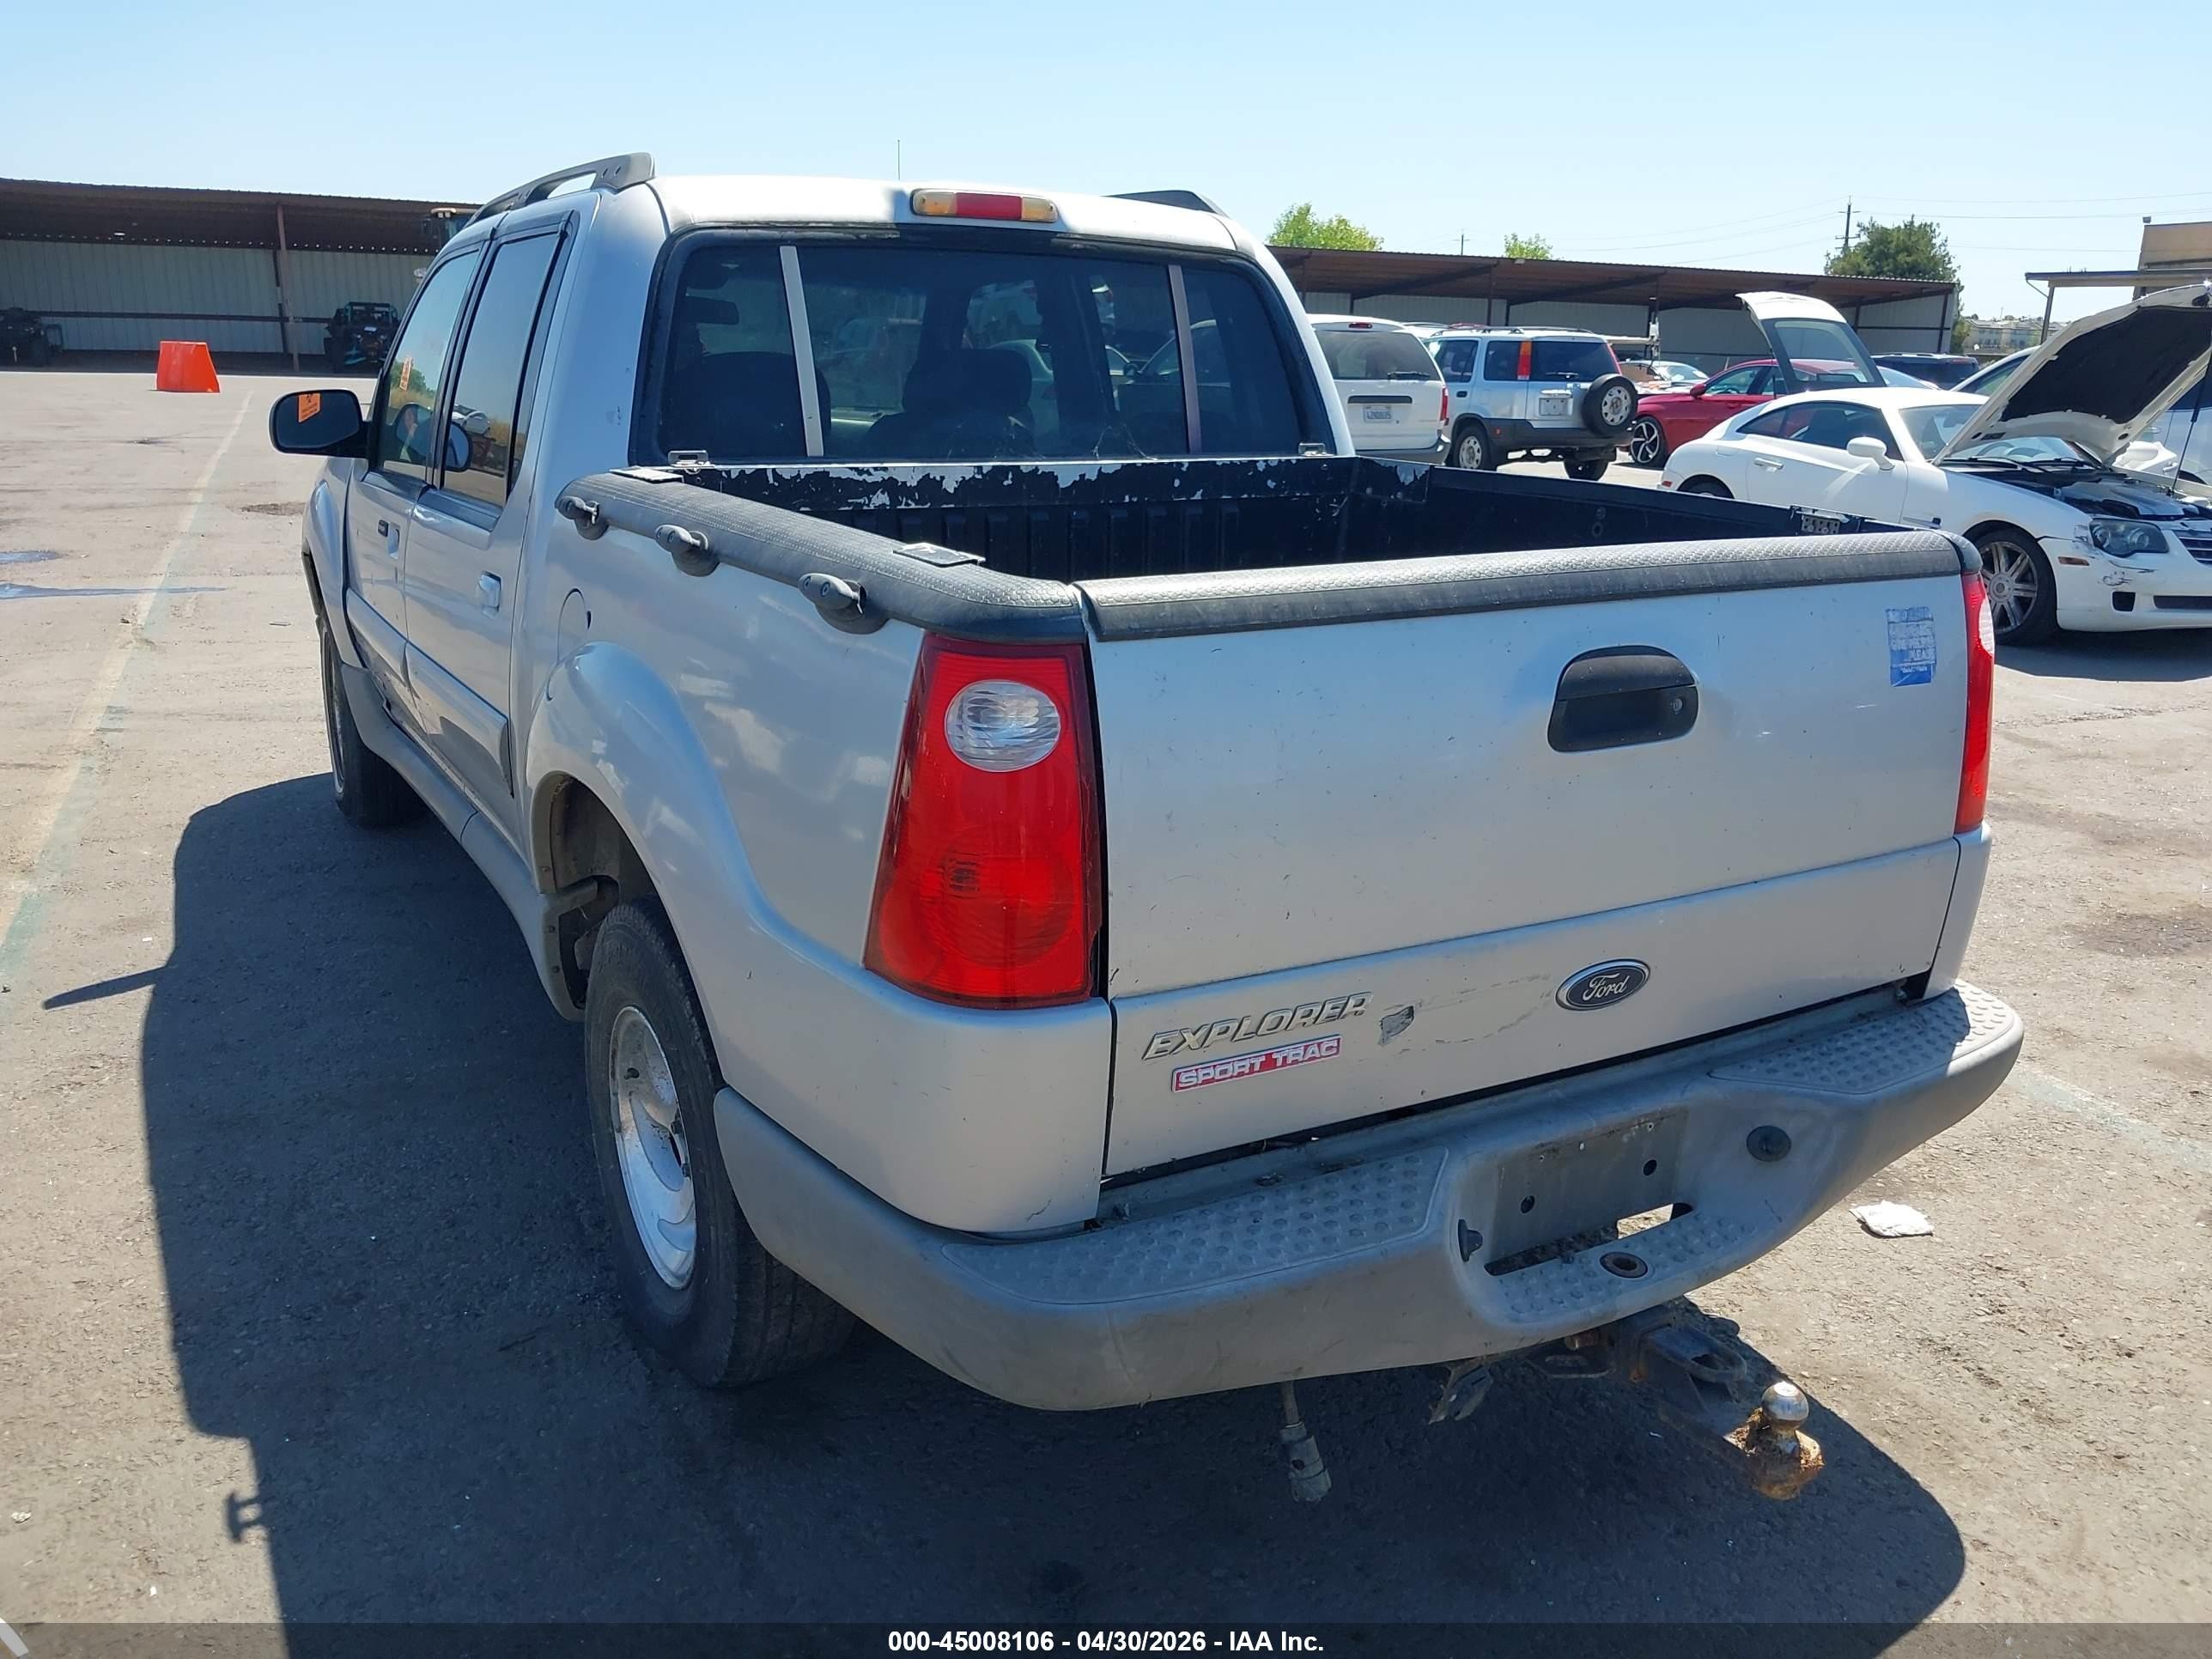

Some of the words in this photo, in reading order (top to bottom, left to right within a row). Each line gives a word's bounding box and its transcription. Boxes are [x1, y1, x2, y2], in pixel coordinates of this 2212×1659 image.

[1582, 972, 1631, 1001] Ford
[1141, 992, 1374, 1060] EXPLORER
[1178, 1056, 1266, 1089] SPORT
[1273, 1039, 1340, 1067] TRAC
